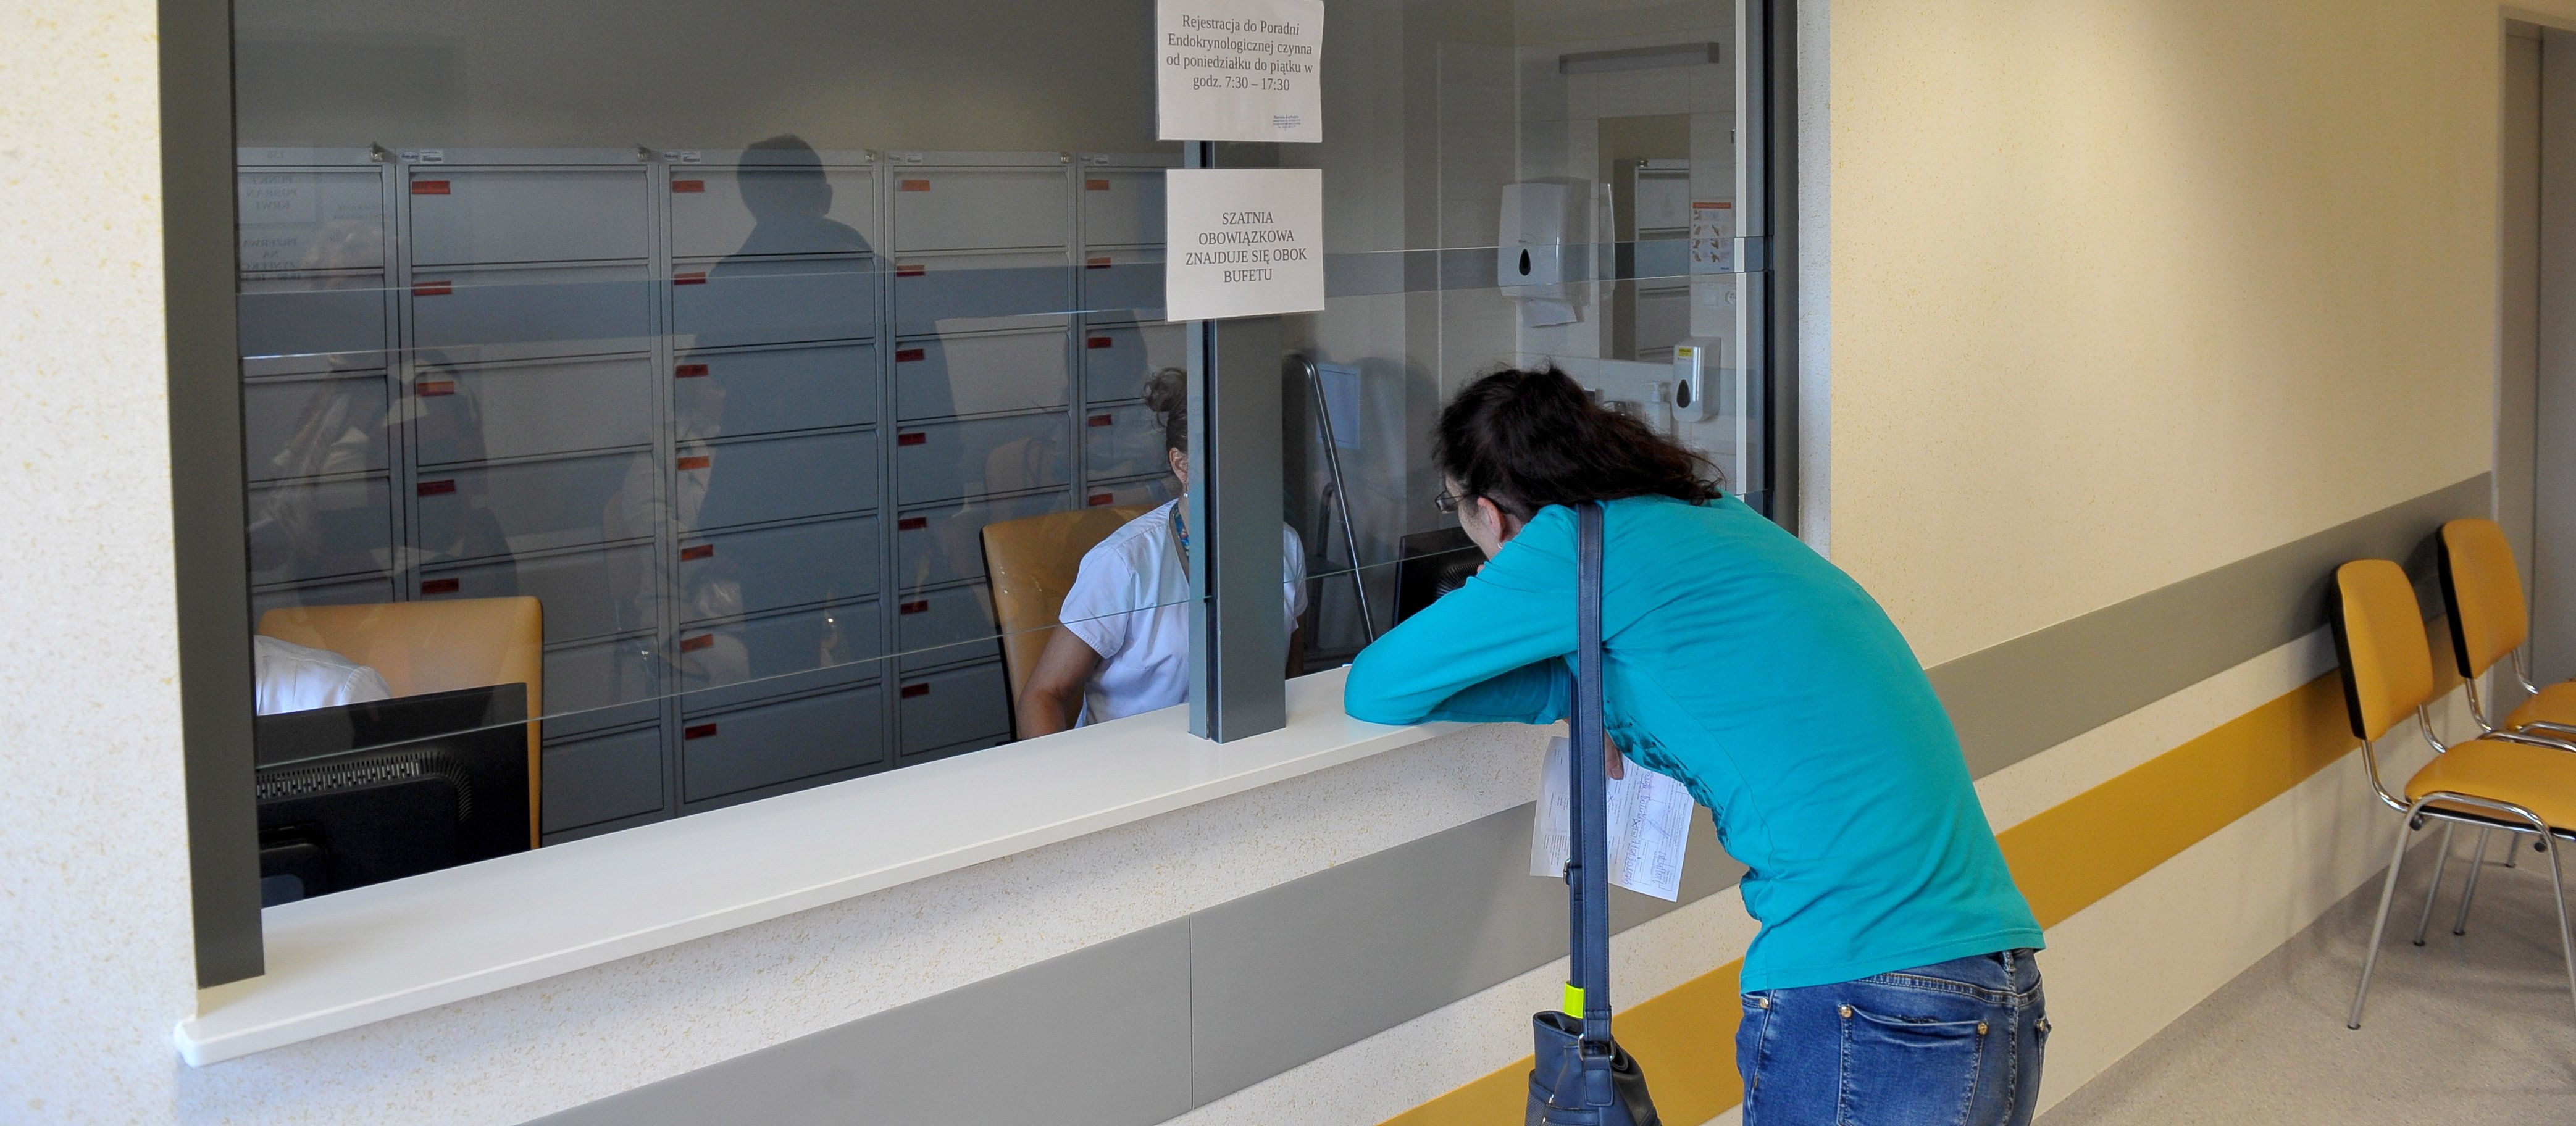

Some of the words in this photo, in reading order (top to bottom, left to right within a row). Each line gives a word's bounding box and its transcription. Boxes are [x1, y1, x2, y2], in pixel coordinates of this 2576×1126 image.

[1183, 15, 1240, 33] Rejestracja
[1244, 19, 1257, 32] do
[1261, 21, 1299, 35] Poradni
[1168, 33, 1273, 56] Endokrynologicznej
[1278, 44, 1311, 56] czynna
[1167, 53, 1180, 65] od
[1184, 55, 1250, 70] poniedziałku
[1255, 59, 1267, 70] do
[1271, 60, 1300, 75] piątku
[1304, 65, 1313, 73] w
[1194, 75, 1221, 90] godz.
[1225, 76, 1248, 88] 7:30
[1261, 78, 1289, 91] 17:30
[1223, 212, 1273, 225] SZATNIA
[1199, 230, 1294, 246] OBOWIĄZKOWA
[1186, 251, 1248, 265] ZNAJDUJE
[1252, 249, 1270, 264] SIĘ
[1273, 248, 1307, 261] OBOK
[1224, 269, 1272, 283] BUFETU
